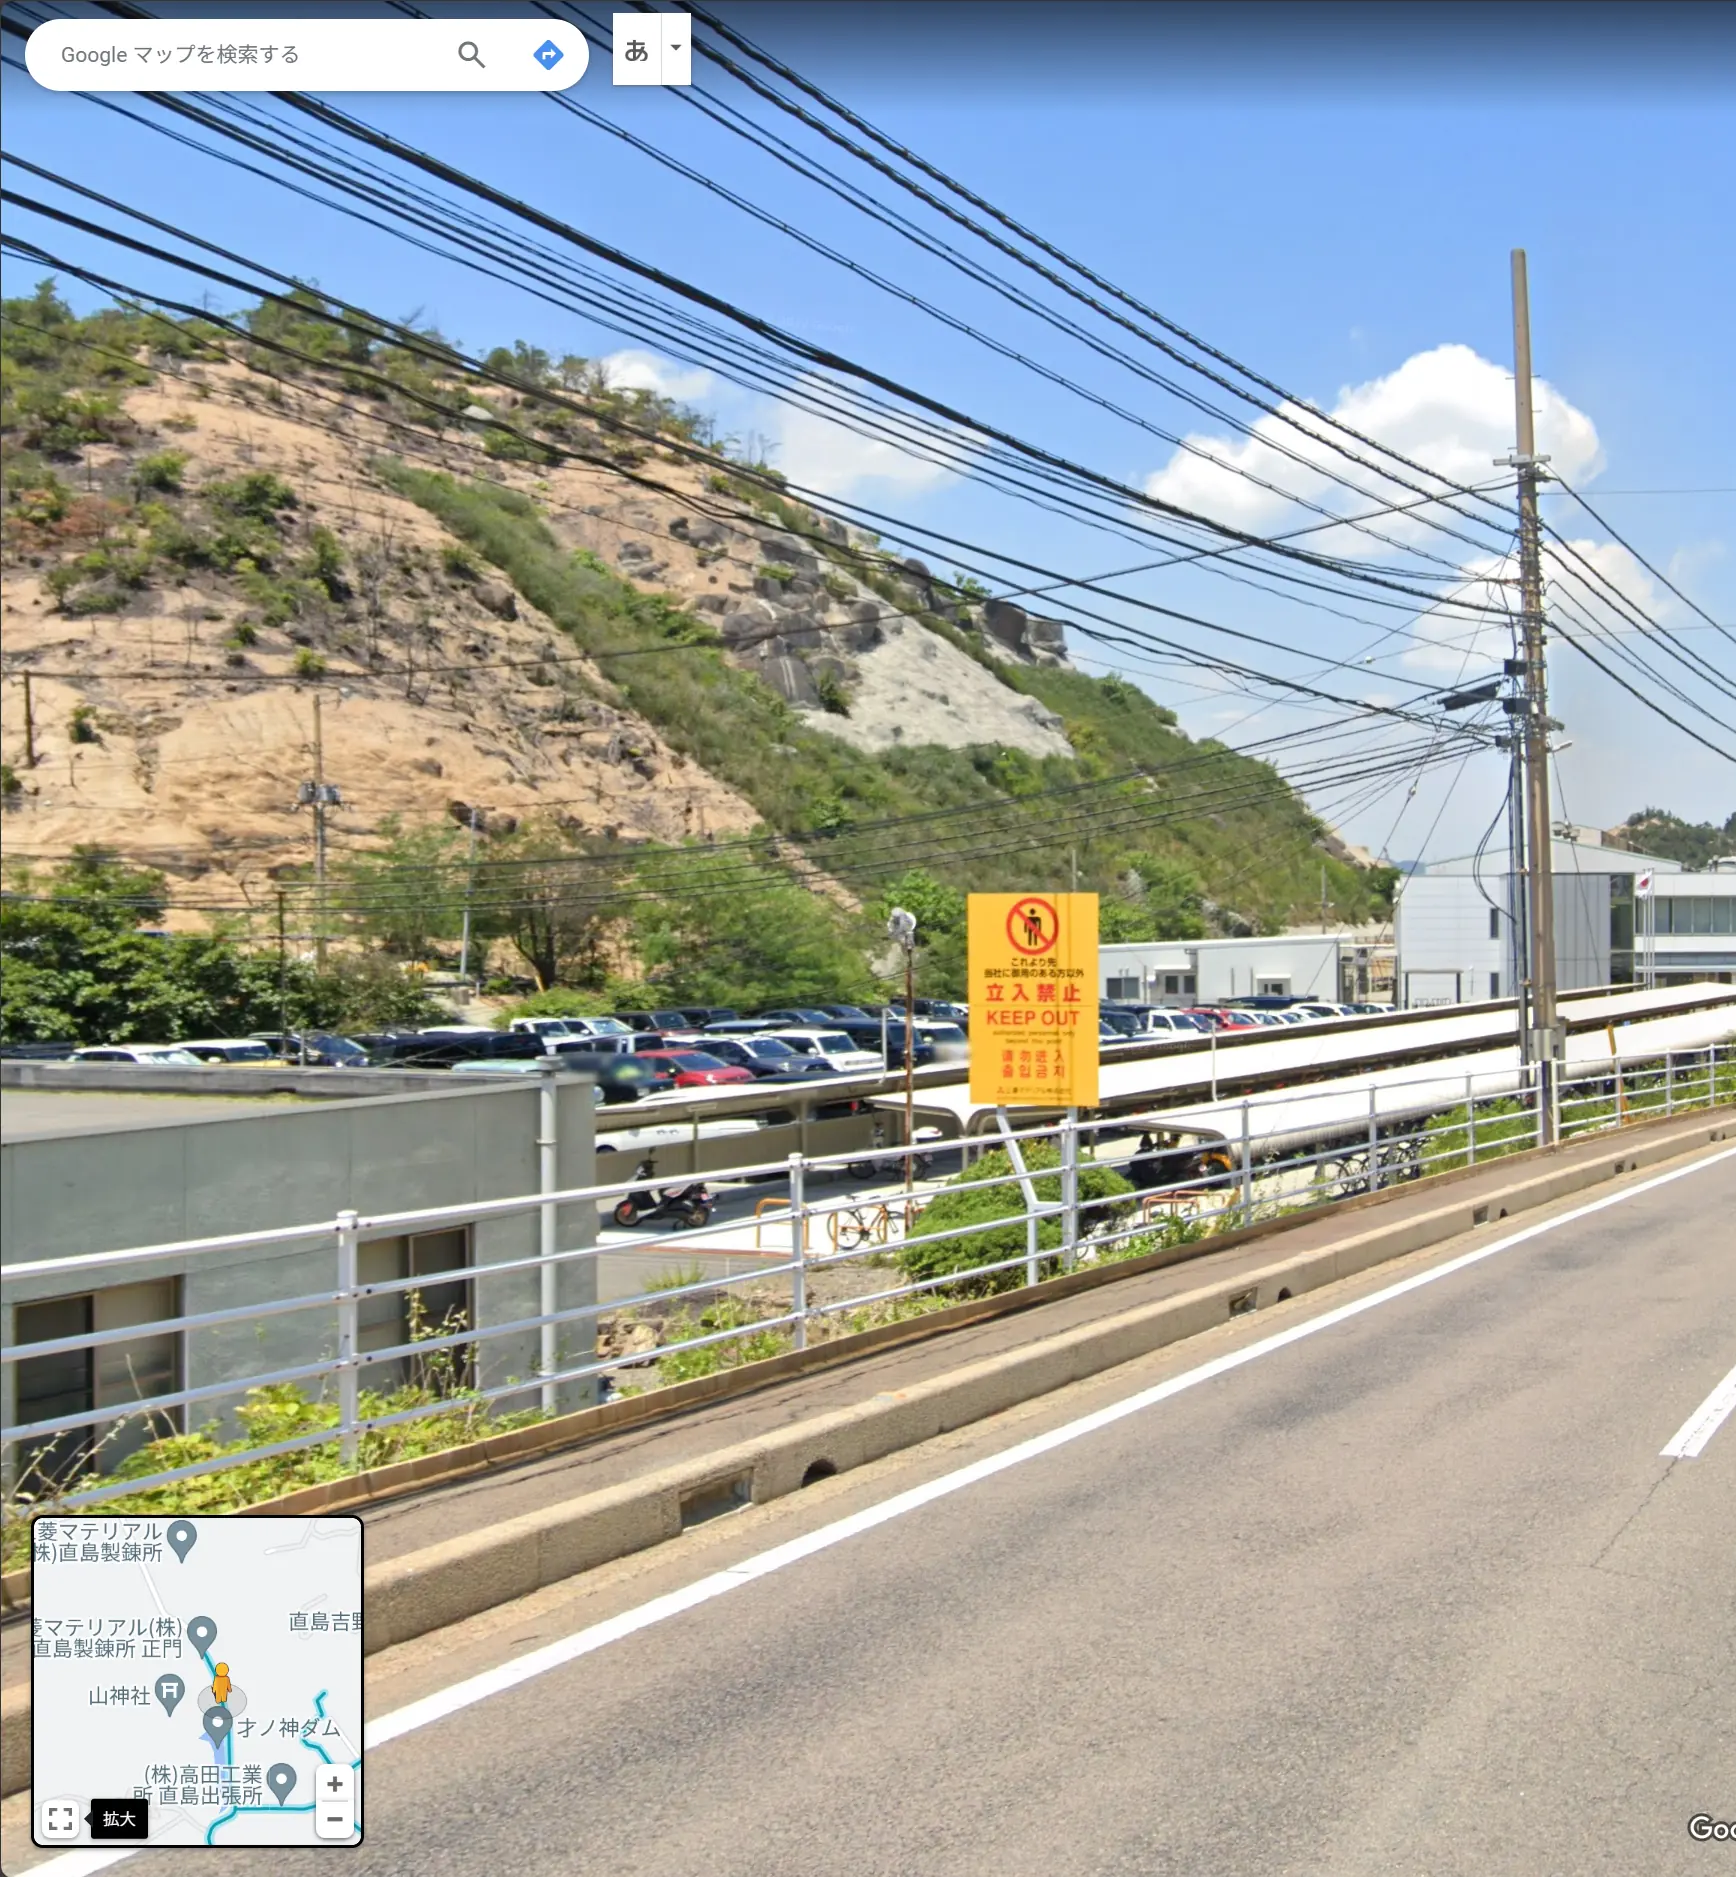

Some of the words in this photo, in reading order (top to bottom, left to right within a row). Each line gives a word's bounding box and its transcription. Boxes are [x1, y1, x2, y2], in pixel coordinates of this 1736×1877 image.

[985, 983, 1081, 1003] 立入禁止
[986, 1010, 1036, 1026] KEEP
[1041, 1010, 1081, 1026] OUT
